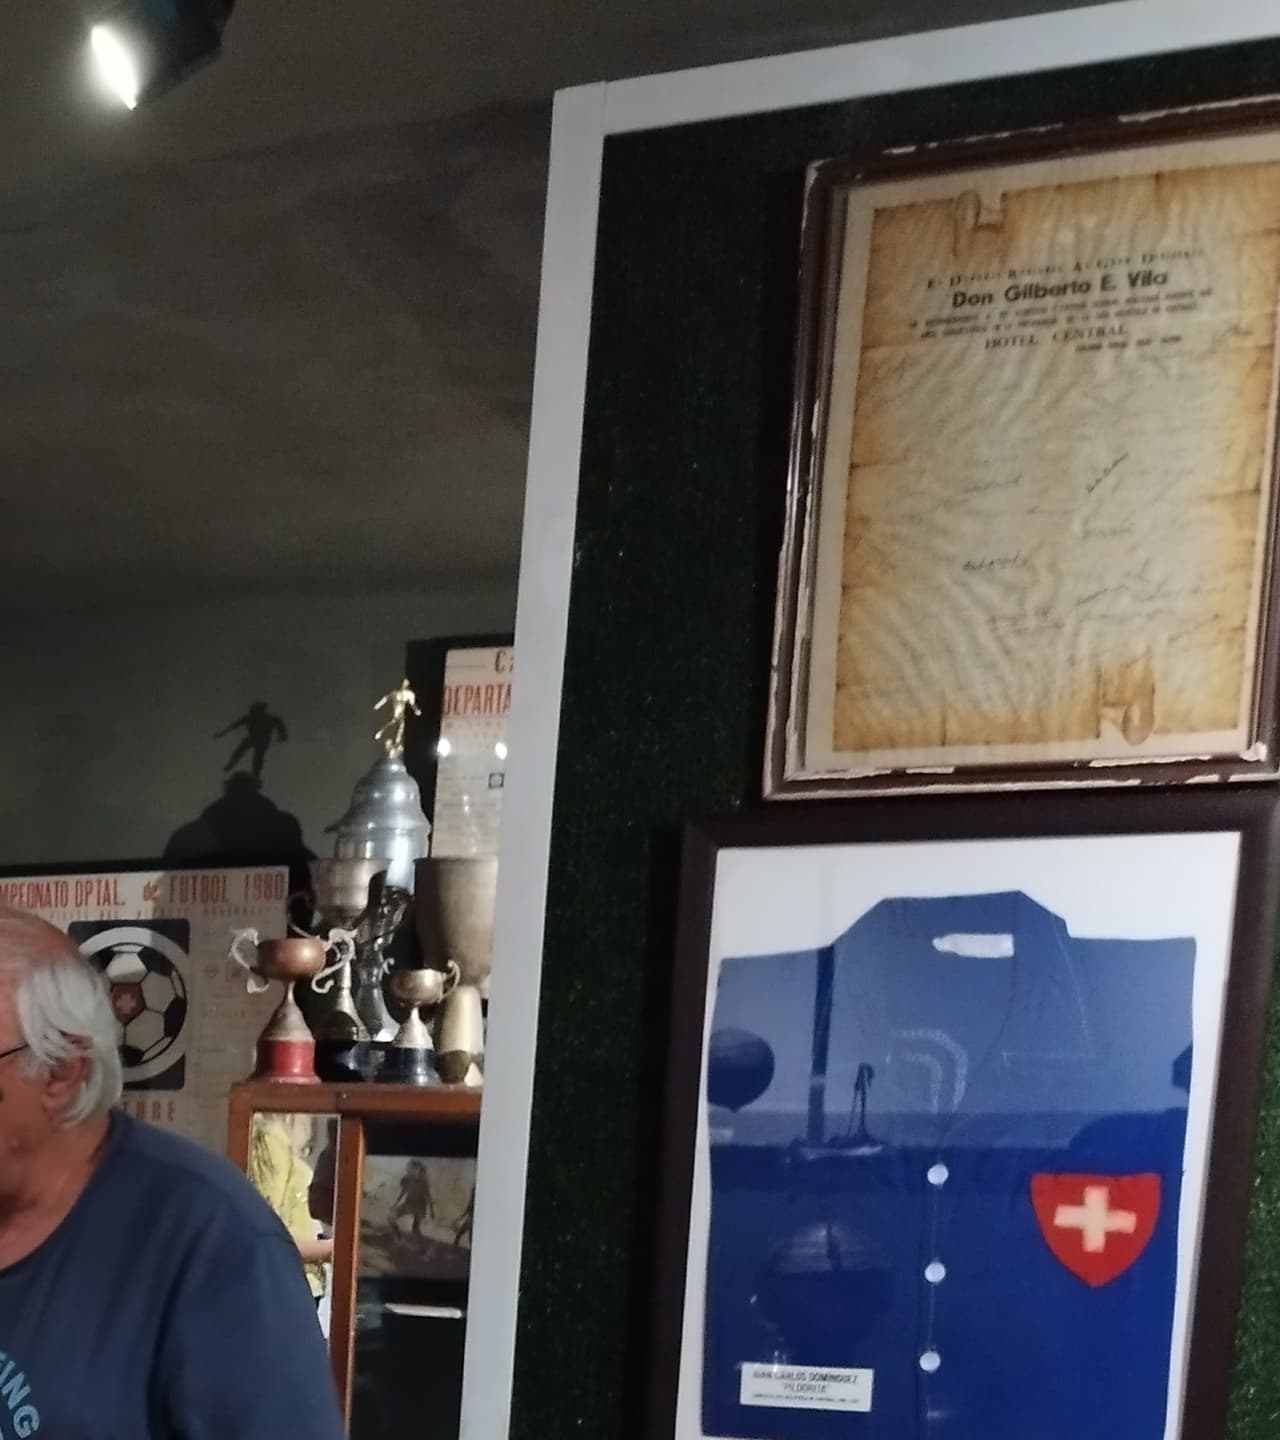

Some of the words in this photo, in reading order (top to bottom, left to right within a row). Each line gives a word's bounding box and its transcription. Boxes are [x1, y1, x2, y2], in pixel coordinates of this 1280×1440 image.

[951, 290, 994, 309] Don
[1004, 278, 1091, 303] Gilberto
[1100, 273, 1117, 291] E.
[1127, 270, 1169, 289] Vila
[985, 336, 1040, 351] HOTEL
[1052, 325, 1129, 343] CENTRAL
